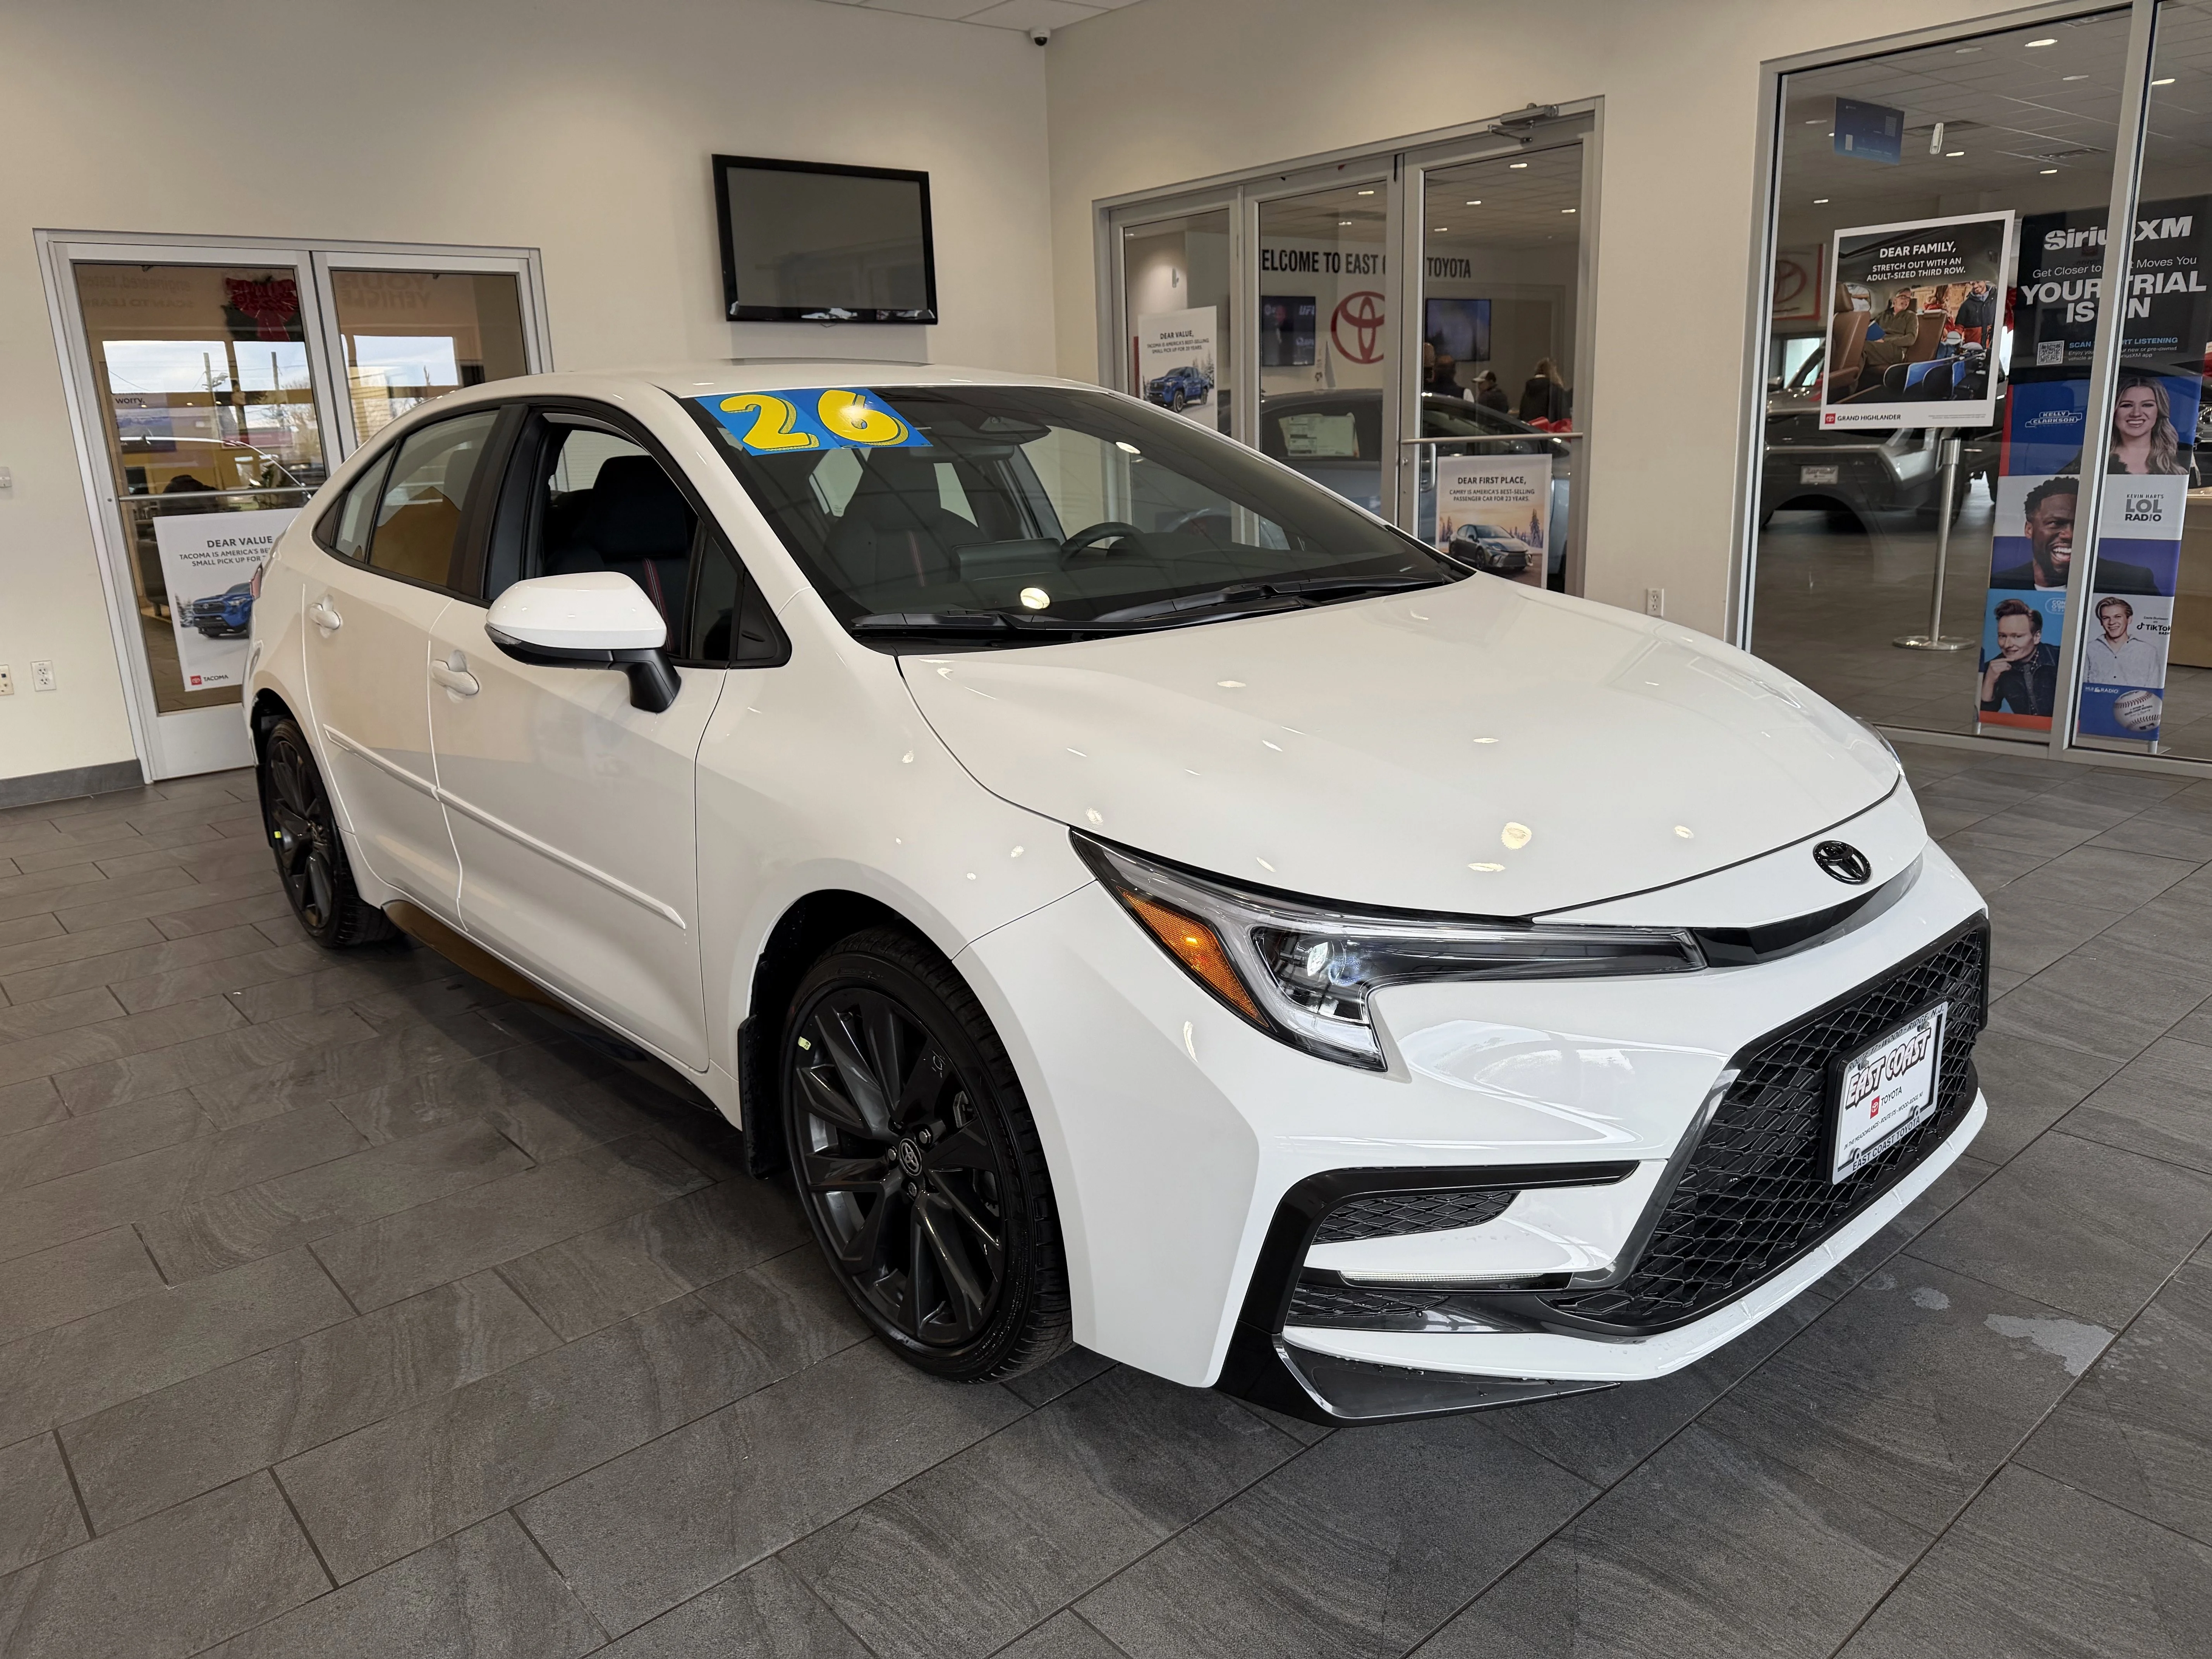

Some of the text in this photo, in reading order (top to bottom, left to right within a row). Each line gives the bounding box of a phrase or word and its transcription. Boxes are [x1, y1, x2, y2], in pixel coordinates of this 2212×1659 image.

[2044, 216, 2193, 250] SiriuXM
[1880, 241, 1956, 258] DEAR FAMILY,
[1262, 249, 1319, 272] ELCOME
[1323, 252, 1340, 273] TO
[1346, 253, 1377, 275] EAST
[1427, 257, 1471, 278] TOYOTA
[1873, 262, 1906, 272] STRETCH
[1927, 258, 1947, 267] WITH
[2136, 258, 2172, 268] Moves
[2176, 256, 2197, 265] You
[1867, 271, 1916, 282] ADULT-SIZED
[1918, 269, 1941, 277] THIRD
[2033, 268, 2051, 278] Get
[2055, 266, 2087, 276] Closer
[2129, 271, 2207, 295] RIAL
[2066, 302, 2094, 323] IS
[1501, 476, 1526, 484] PLACE,
[2126, 499, 2162, 513] LOL
[207, 536, 273, 548] DEAR VALUE
[221, 548, 258, 556] AMERICA'S
[1848, 1051, 1870, 1072] ROUTE
[1931, 1005, 1944, 1017] N.J.
[1845, 1028, 1931, 1110] EAST COAST
[1881, 1086, 1902, 1106] TOYOTA
[1853, 1116, 1920, 1171] EAST COAST TOYOTA
